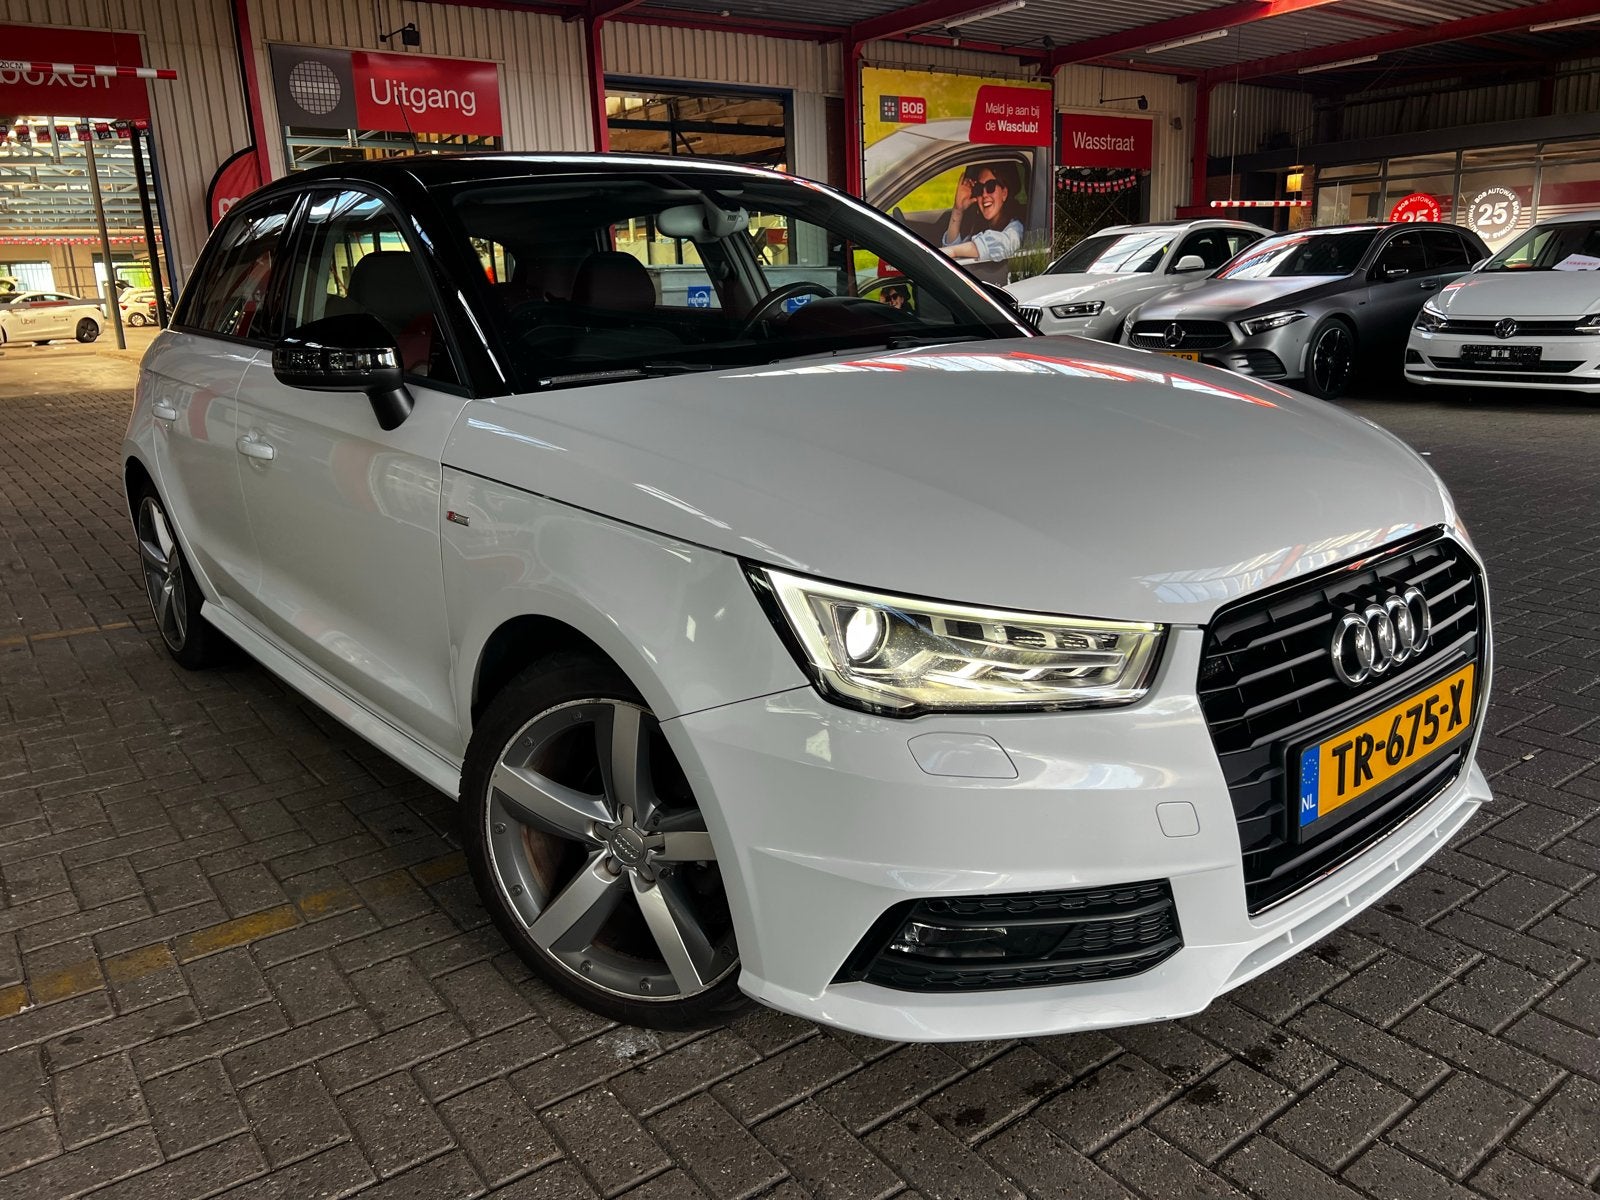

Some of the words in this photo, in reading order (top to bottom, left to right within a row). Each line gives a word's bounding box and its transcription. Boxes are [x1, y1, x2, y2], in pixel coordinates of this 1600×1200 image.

[370, 78, 477, 117] Uitgang
[901, 102, 924, 114] BOB
[985, 102, 1005, 115] Meld
[1006, 104, 1014, 117] je
[1015, 106, 1030, 116] aan
[1031, 105, 1040, 119] bij
[985, 120, 996, 131] de
[997, 120, 1039, 133] Wasclub!
[1073, 131, 1135, 152] Wasstraat
[1474, 192, 1488, 203] BOB
[1488, 187, 1515, 201] AUTOWAS
[1401, 208, 1429, 222] 25
[1477, 202, 1508, 226] 25
[1331, 679, 1465, 797] TR-675-X
[1301, 793, 1316, 813] NL
